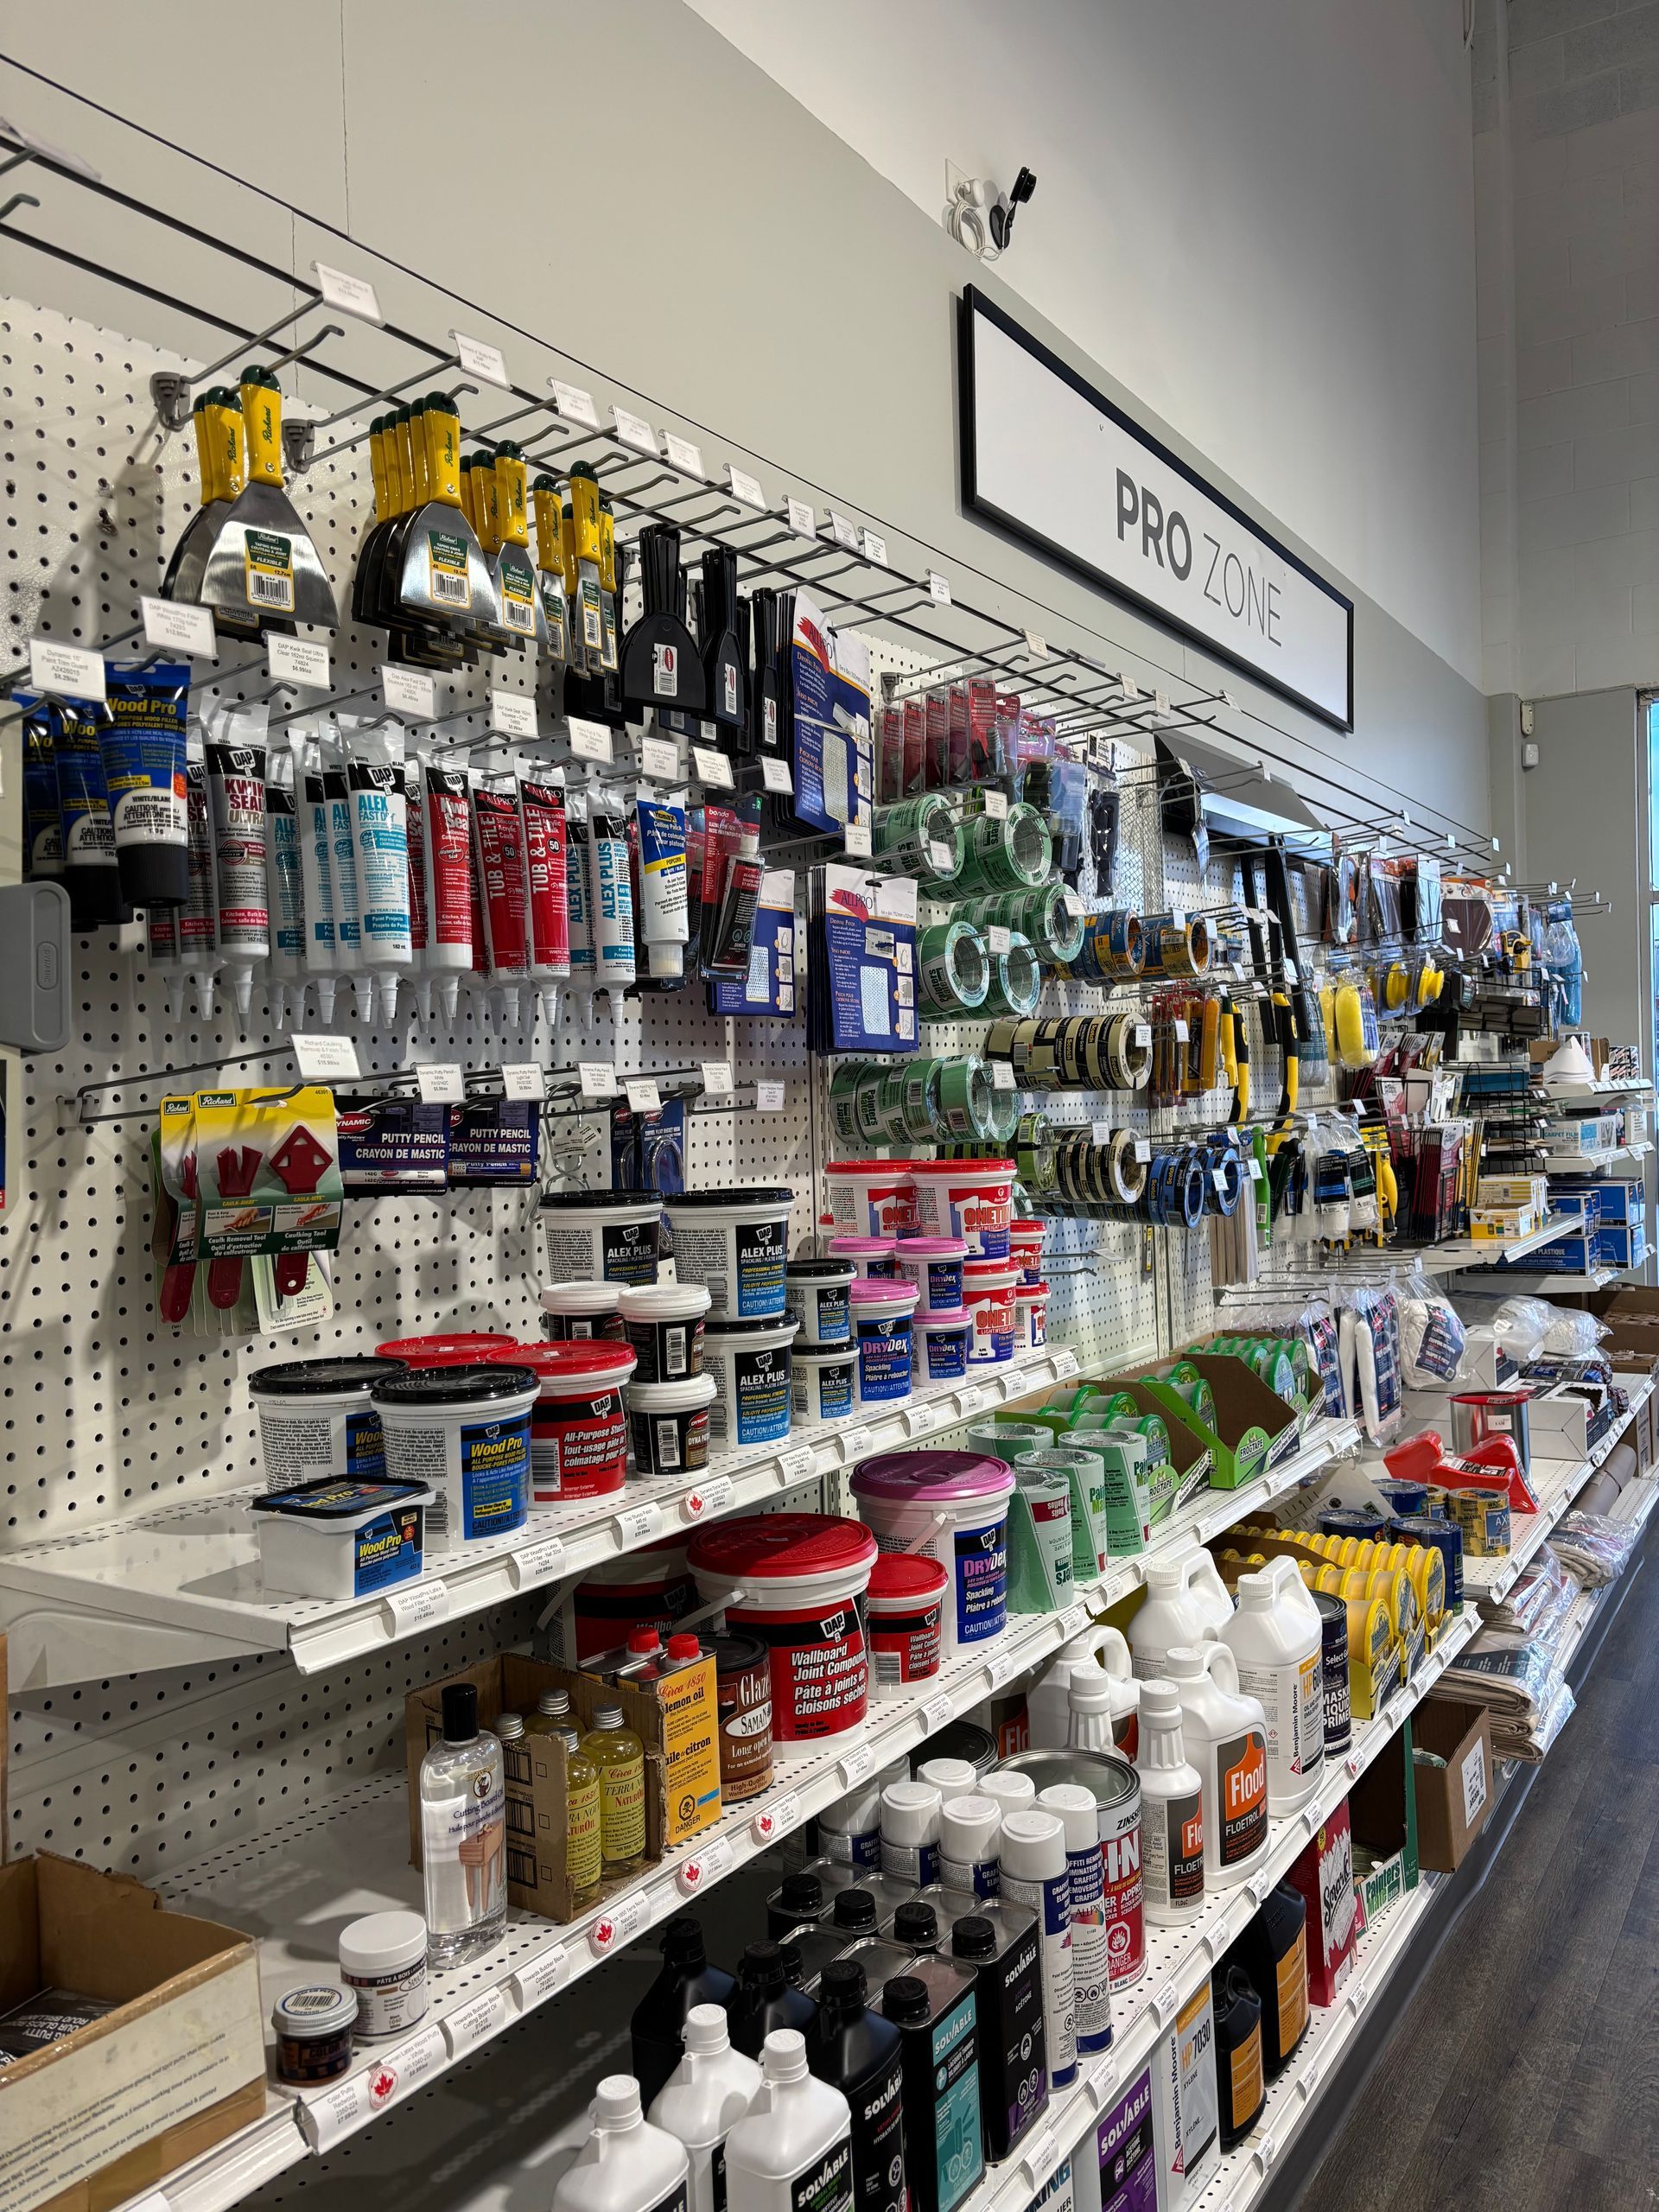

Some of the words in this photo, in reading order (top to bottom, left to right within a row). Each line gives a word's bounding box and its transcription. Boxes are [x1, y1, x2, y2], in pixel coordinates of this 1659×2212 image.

[257, 557, 283, 566] FLEXIBLE
[438, 556, 461, 566] FLEXIBLE
[1116, 467, 1192, 582] PRO
[1204, 532, 1281, 647] ZONE
[150, 700, 176, 715] Pro
[232, 752, 253, 766] DAP
[372, 769, 392, 784] DAP
[225, 779, 264, 794] KWIK
[229, 795, 264, 810] SEAL
[359, 794, 388, 810] ALEX
[757, 798, 761, 809] 2
[359, 811, 378, 821] FAST
[525, 808, 545, 845] TILE
[530, 847, 547, 858] &
[549, 840, 560, 850] 50
[598, 842, 612, 880] PLUS
[531, 864, 549, 894] TUB
[600, 882, 617, 920] ALEX
[842, 891, 873, 910] ALLPRO
[1088, 1024, 1098, 1043] Scotch
[1110, 1056, 1122, 1077] Scotch
[168, 1103, 189, 1114] Richard
[201, 1096, 232, 1106] Richard
[336, 1118, 372, 1127] YNAMIC
[381, 1134, 410, 1144] PUTTY
[413, 1133, 446, 1144] PENCIL
[470, 1128, 499, 1139] PUTTY
[500, 1128, 531, 1139] PENCIL
[356, 1148, 395, 1160] CRAYON
[397, 1149, 409, 1159] DE
[411, 1148, 445, 1160] MASTIC
[449, 1143, 481, 1154] CRAYON
[484, 1143, 496, 1153] DE
[498, 1143, 531, 1154] MASTIC
[964, 1205, 1010, 1225] ONETI
[760, 1229, 771, 1239] DAP
[226, 1243, 263, 1251] d'extraction
[607, 1247, 632, 1258] ALEX
[634, 1245, 652, 1256] PLUS
[741, 1247, 764, 1258] ALEX
[767, 1245, 783, 1256] PLUS
[865, 1363, 891, 1372] Spackling
[564, 1427, 609, 1443] All-Purpose
[470, 1440, 505, 1458] Wood
[506, 1438, 523, 1452] Pro
[564, 1441, 606, 1456] Tout-usage
[1240, 1438, 1264, 1459] FROGTAPE
[564, 1452, 604, 1467] colmatage
[606, 1450, 620, 1464] pour
[359, 1538, 385, 1558] Wood
[386, 1535, 402, 1548] Pro
[966, 1586, 995, 1601] Spackling
[909, 1630, 935, 1643] Wallboard
[791, 1643, 848, 1667] Wallboard
[1325, 1653, 1342, 1666] Select
[794, 1665, 824, 1681] Joint
[828, 1650, 866, 1676] Compoun
[660, 1682, 684, 1700] Circa
[686, 1672, 706, 1690] 1850
[795, 1685, 821, 1700] Pâte
[825, 1681, 831, 1695] à
[833, 1674, 857, 1695] joints
[859, 1669, 865, 1681] de
[664, 1695, 691, 1714] lemon
[693, 1688, 704, 1701] oil
[795, 1697, 841, 1715] cloisons
[843, 1683, 866, 1705] sèches
[685, 1738, 711, 1756] citron
[732, 1745, 752, 1758] Long
[608, 1768, 632, 1779] Circa
[605, 1783, 634, 1797] TERRA
[728, 1784, 757, 1797] Waterbased
[730, 1775, 766, 1791] High-Quality
[1230, 1762, 1265, 1808] Flood
[454, 1803, 480, 1820] Cutting
[480, 1792, 498, 1809] Board
[448, 1824, 462, 1834] Huile
[464, 1819, 475, 1831] pour
[676, 1815, 701, 1834] DANGER
[1225, 1811, 1260, 1836] FLOETROL
[1074, 1872, 1098, 1884] GRAFFITI
[1075, 1892, 1099, 1903] GRAFFITI
[552, 1954, 565, 1966] Block
[1004, 1945, 1037, 1988] SOLVABLE
[1108, 1952, 1130, 1967] DANGER
[376, 1976, 393, 1986] PÂTE
[398, 1970, 411, 1981] BOIS
[1115, 1979, 1128, 1989] BLANC
[489, 2002, 499, 2012] Oil
[934, 2010, 973, 2056] SOLVABLE
[1181, 2045, 1193, 2072] HP
[1192, 2018, 1211, 2059] 7030
[1183, 2069, 1198, 2091] XYLENE
[1102, 2082, 1150, 2156] SOLVABLE
[1173, 2083, 1181, 2150] Benjamin
[798, 2146, 849, 2209] SOLVABLE
